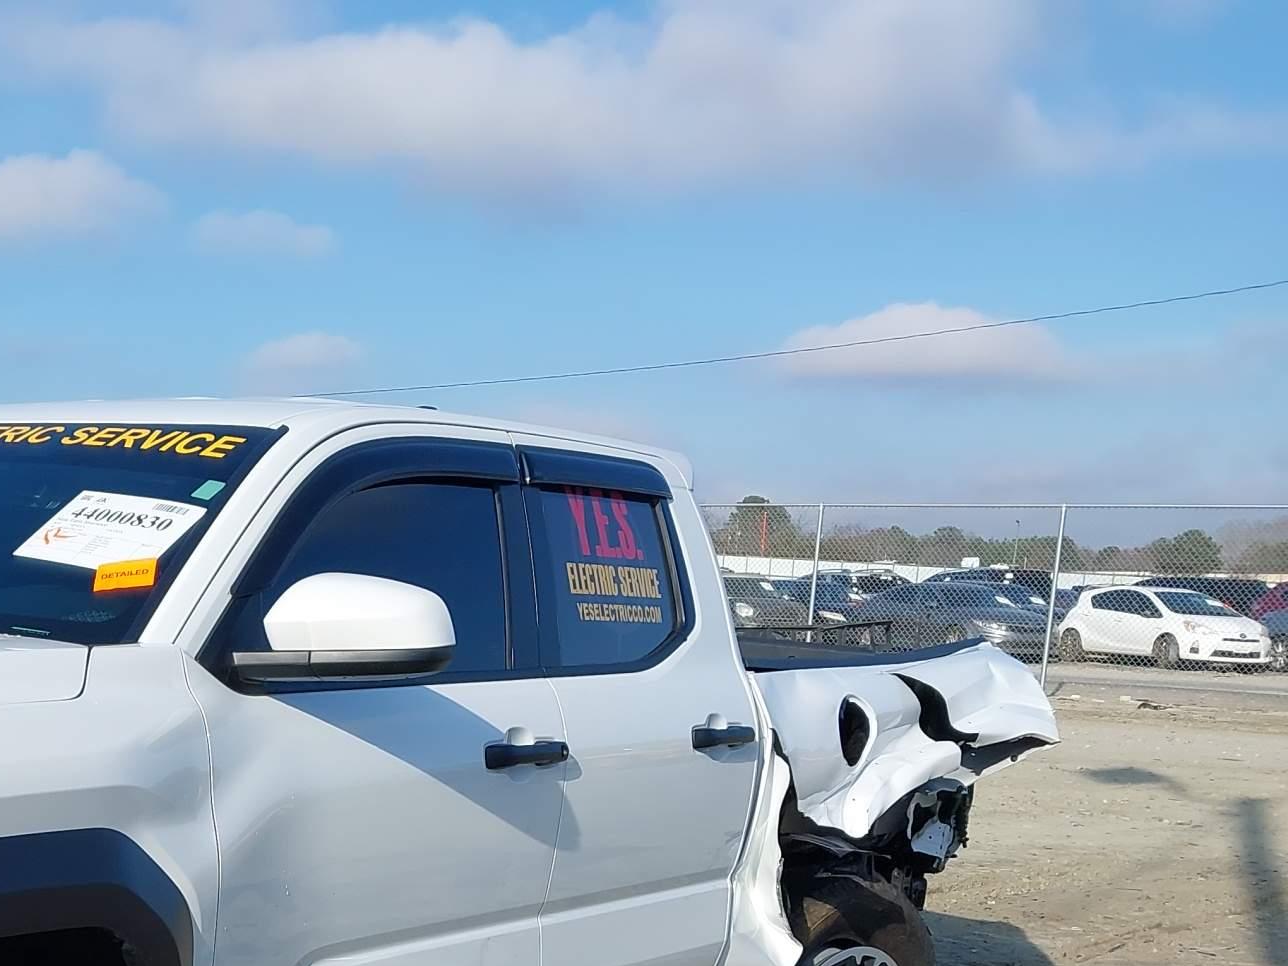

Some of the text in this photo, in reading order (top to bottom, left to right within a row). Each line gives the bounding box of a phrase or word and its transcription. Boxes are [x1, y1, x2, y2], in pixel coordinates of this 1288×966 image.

[61, 426, 247, 459] SERVICE
[72, 506, 174, 532] 44000830
[101, 568, 150, 580] DETAILED
[566, 562, 662, 599] ELECTRIC SERVICE
[576, 602, 663, 624] YESELECTRICCO.COM
